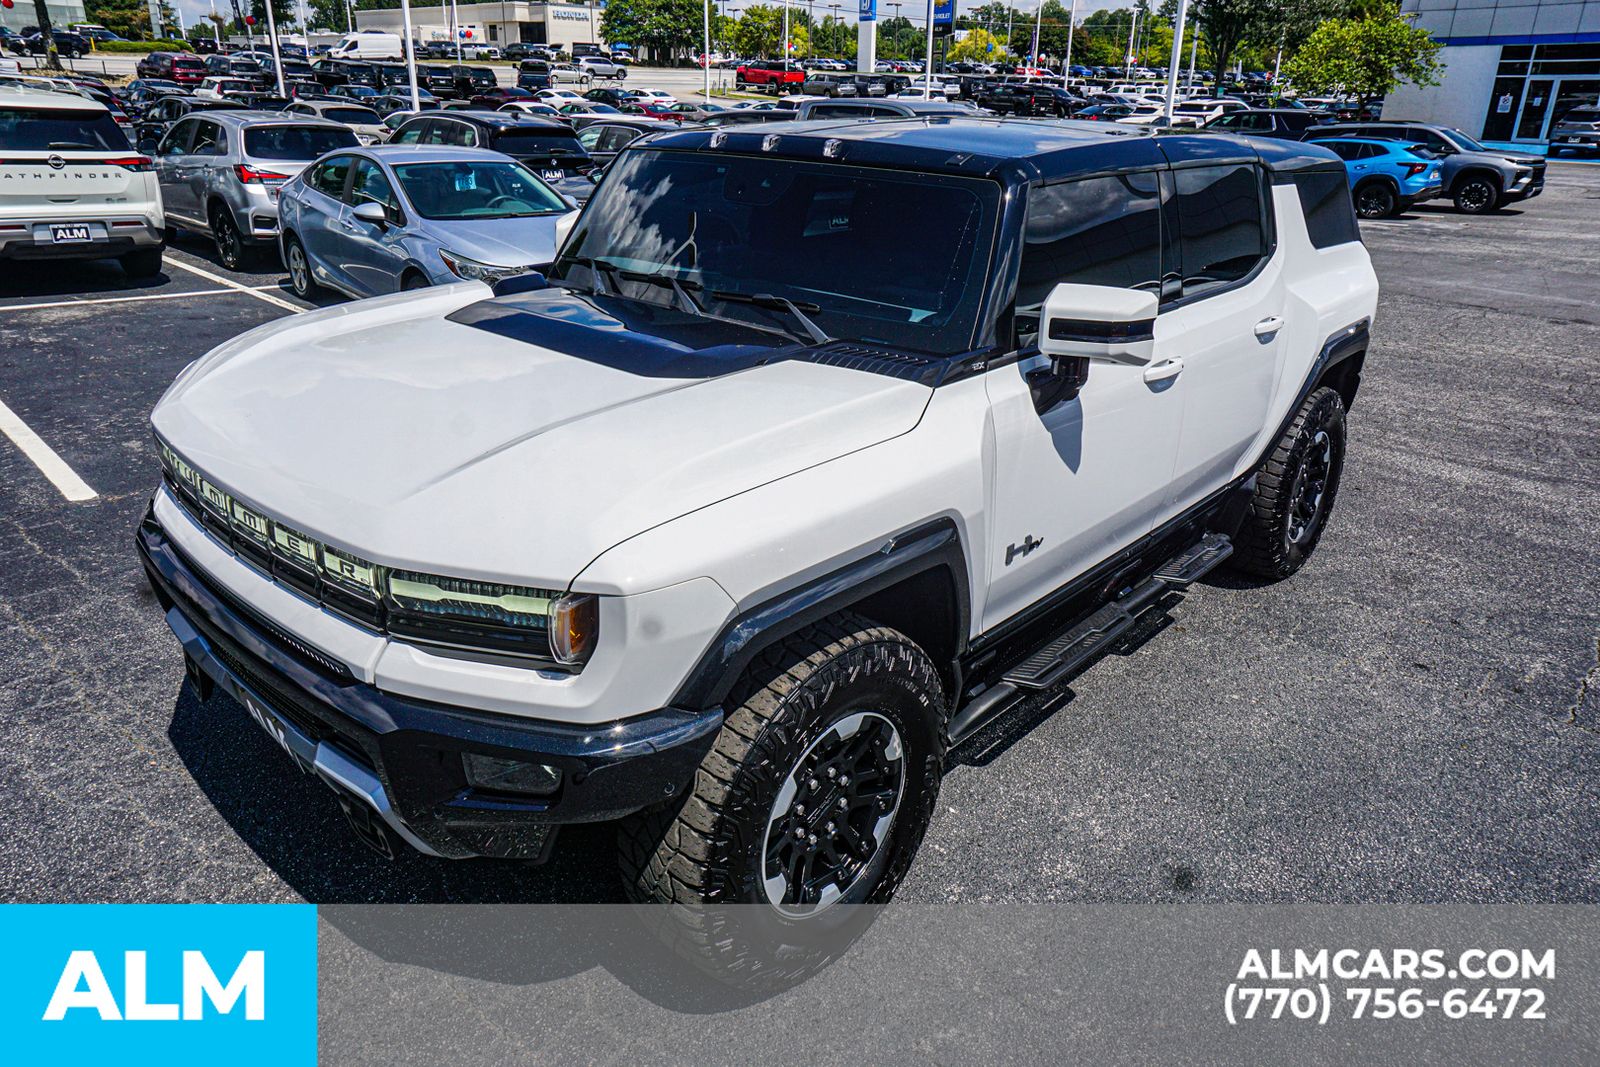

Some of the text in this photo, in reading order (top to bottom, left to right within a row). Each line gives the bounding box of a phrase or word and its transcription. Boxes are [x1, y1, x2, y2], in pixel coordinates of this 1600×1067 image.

[553, 10, 590, 20] HONDA
[545, 171, 562, 179] ALM
[56, 228, 88, 239] ALM
